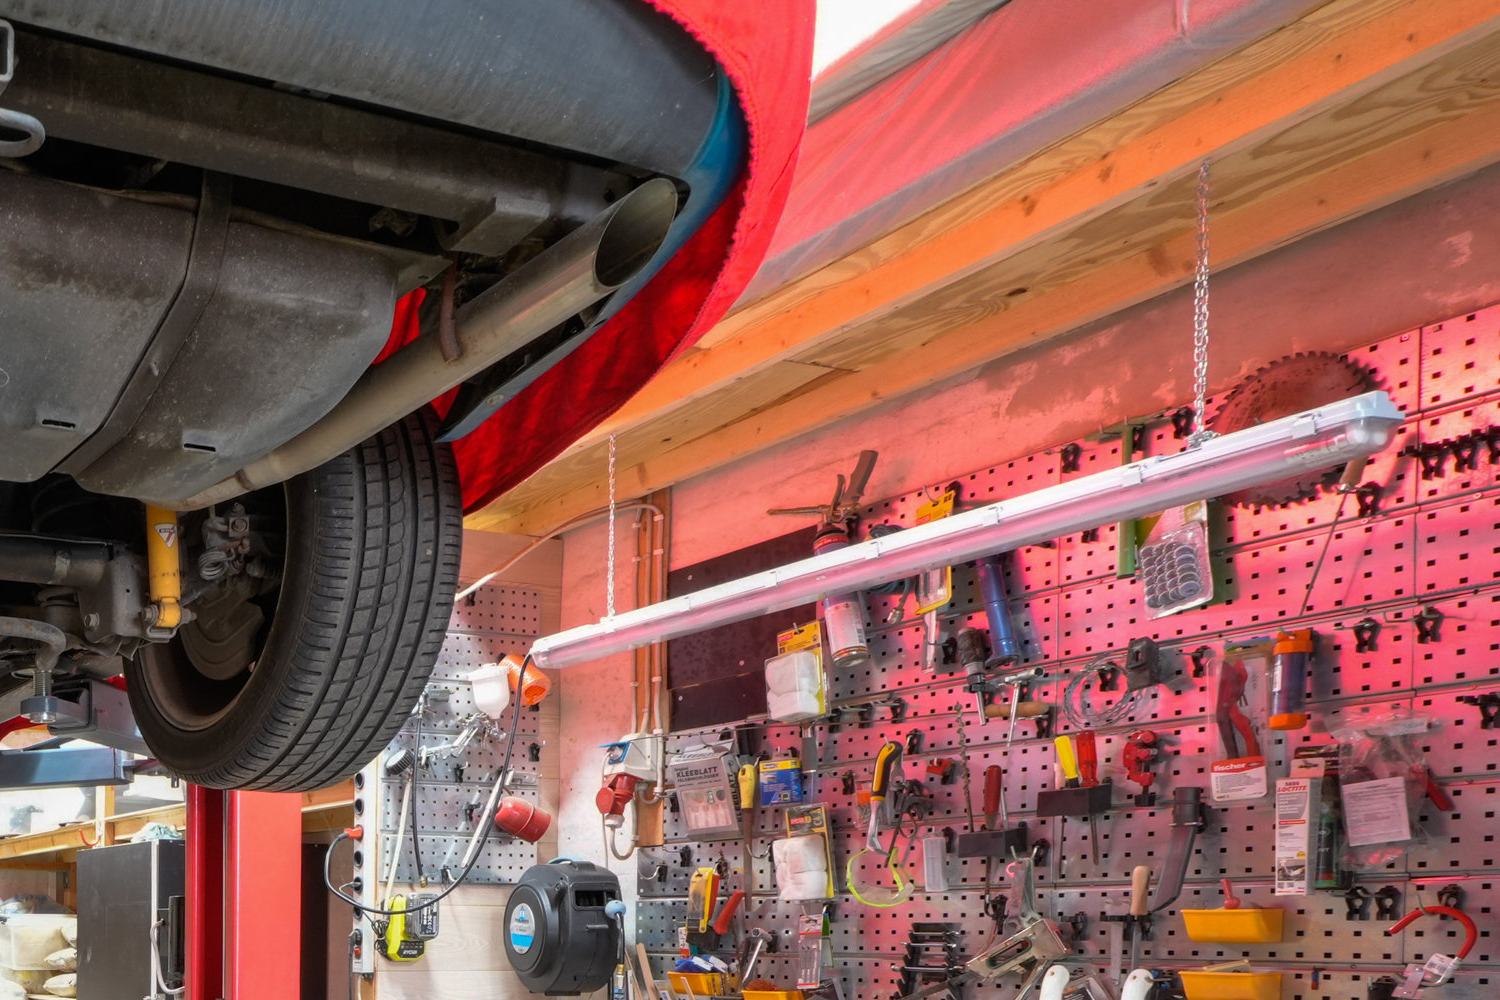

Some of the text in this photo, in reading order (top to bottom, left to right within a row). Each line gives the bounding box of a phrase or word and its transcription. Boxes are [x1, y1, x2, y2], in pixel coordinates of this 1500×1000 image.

[676, 766, 718, 778] KLEEBLATT
[1214, 763, 1245, 772] fischer
[1277, 785, 1307, 793] LOCTITE
